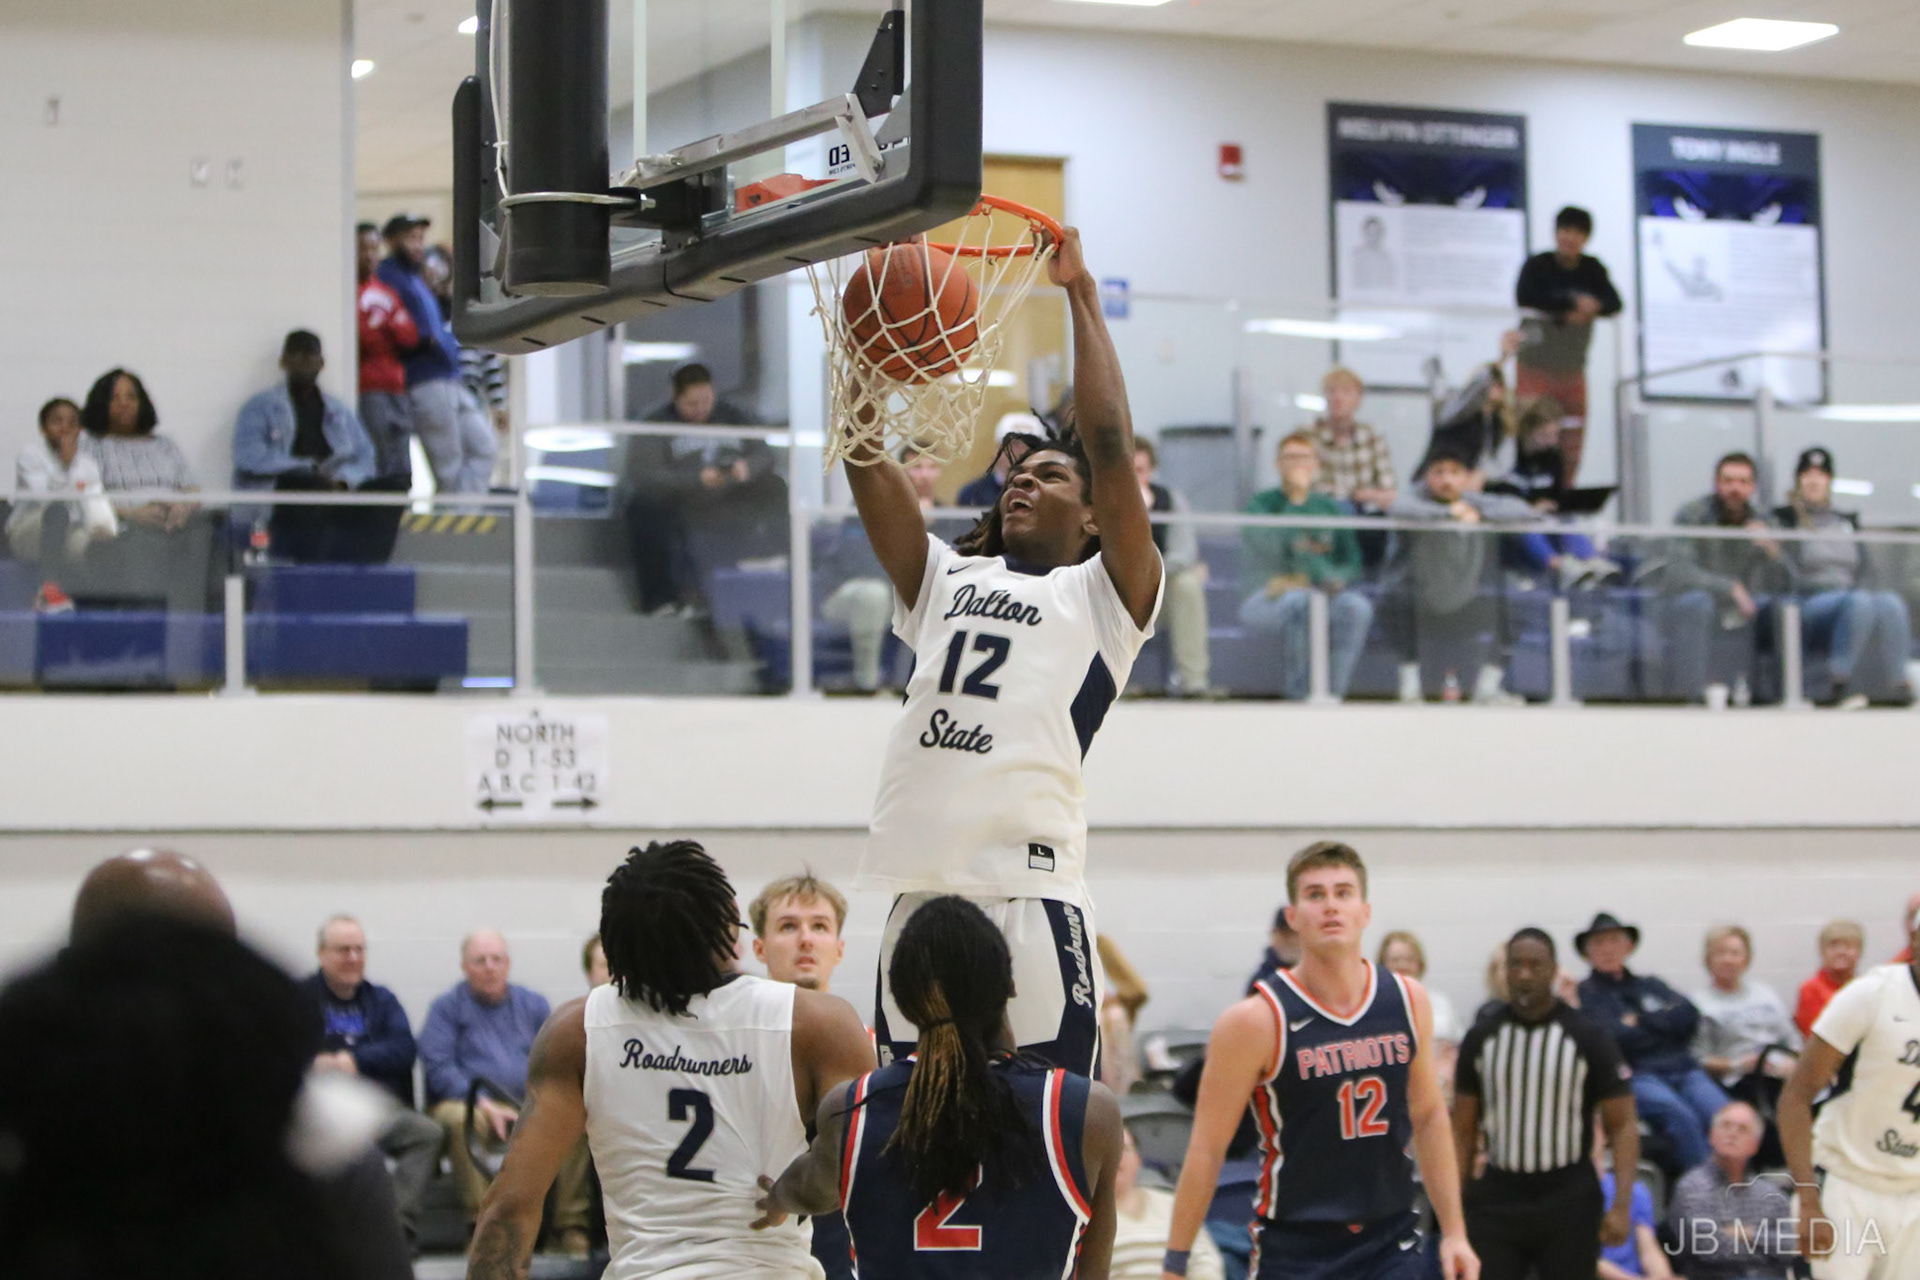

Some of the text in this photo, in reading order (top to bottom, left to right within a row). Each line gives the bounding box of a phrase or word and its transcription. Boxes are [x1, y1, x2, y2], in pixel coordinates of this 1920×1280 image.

[944, 584, 1042, 626] Dalton
[937, 628, 1014, 702] 12
[496, 723, 575, 744] NORTH
[920, 708, 993, 754] State
[494, 748, 511, 769] D
[1037, 846, 1045, 856] L
[619, 1038, 753, 1076] Roadrunners
[1296, 1033, 1410, 1080] PATRIOTS
[1337, 1076, 1389, 1140] 12
[666, 1088, 717, 1183] 2
